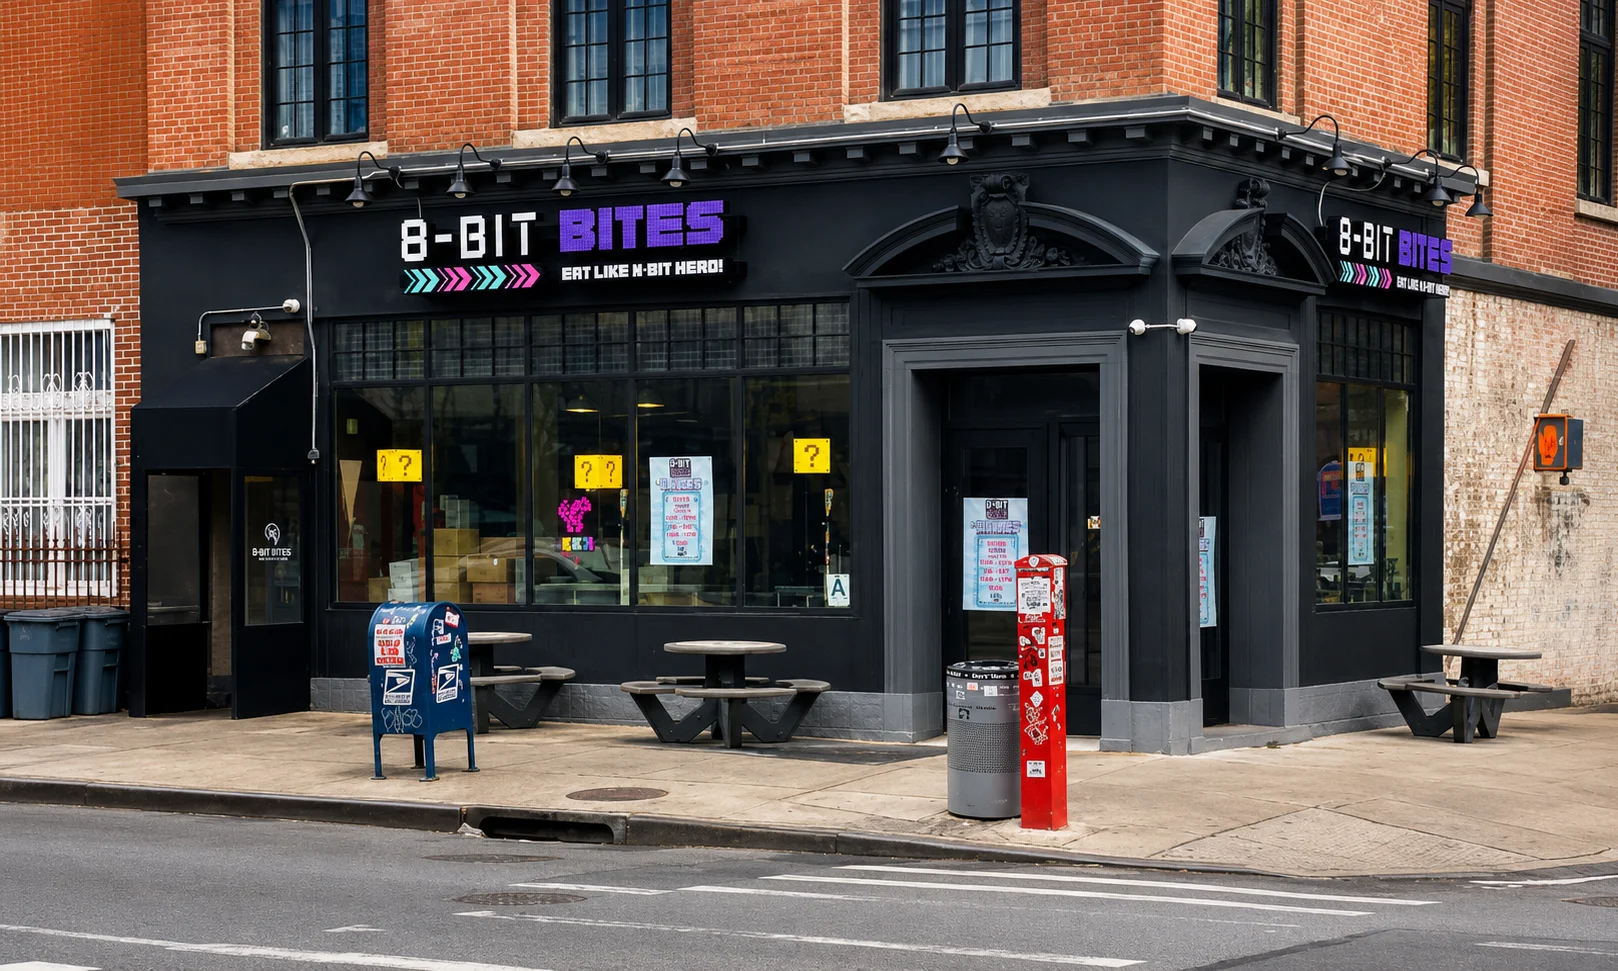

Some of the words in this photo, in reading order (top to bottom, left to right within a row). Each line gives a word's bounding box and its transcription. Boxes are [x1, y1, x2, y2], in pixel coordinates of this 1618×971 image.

[401, 211, 537, 262] 8-BIT
[559, 200, 724, 252] BITES
[1339, 216, 1394, 263] 8-BIT
[1398, 229, 1453, 275] BITES
[561, 266, 591, 281] EAT
[593, 264, 629, 279] LIKE
[675, 259, 724, 275] HERO!
[831, 578, 846, 596] A
